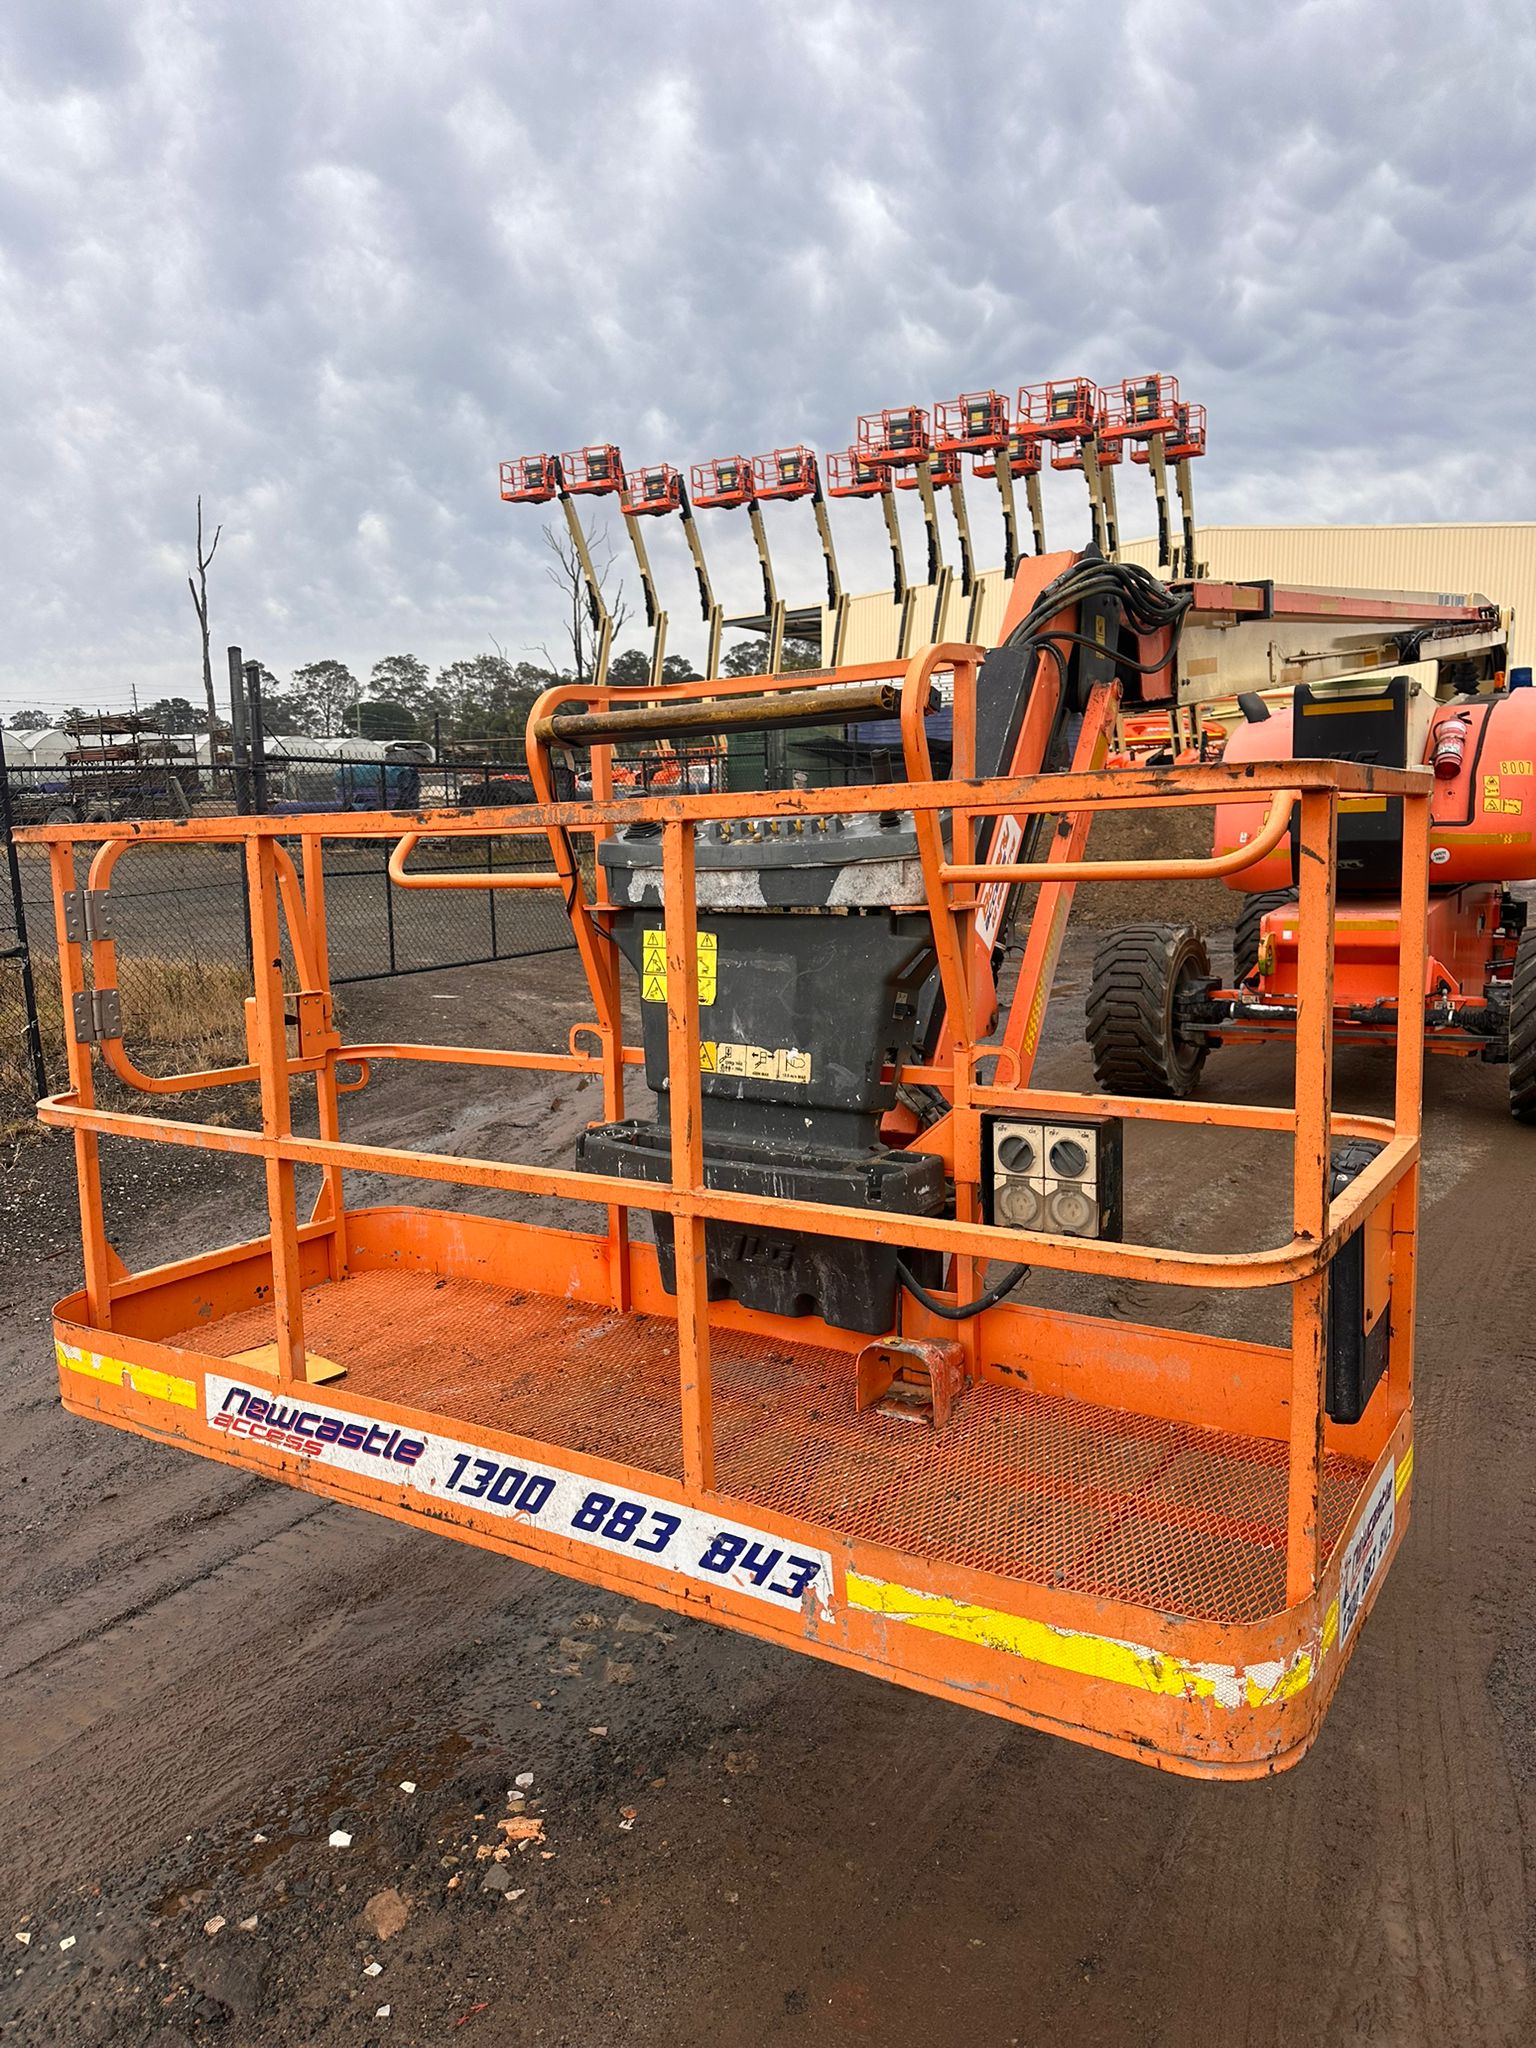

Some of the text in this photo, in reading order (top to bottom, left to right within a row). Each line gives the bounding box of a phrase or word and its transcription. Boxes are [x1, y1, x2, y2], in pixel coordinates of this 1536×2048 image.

[1501, 761, 1531, 774] 8007
[213, 1412, 324, 1456] access
[445, 1453, 821, 1599] 1300 883 843
